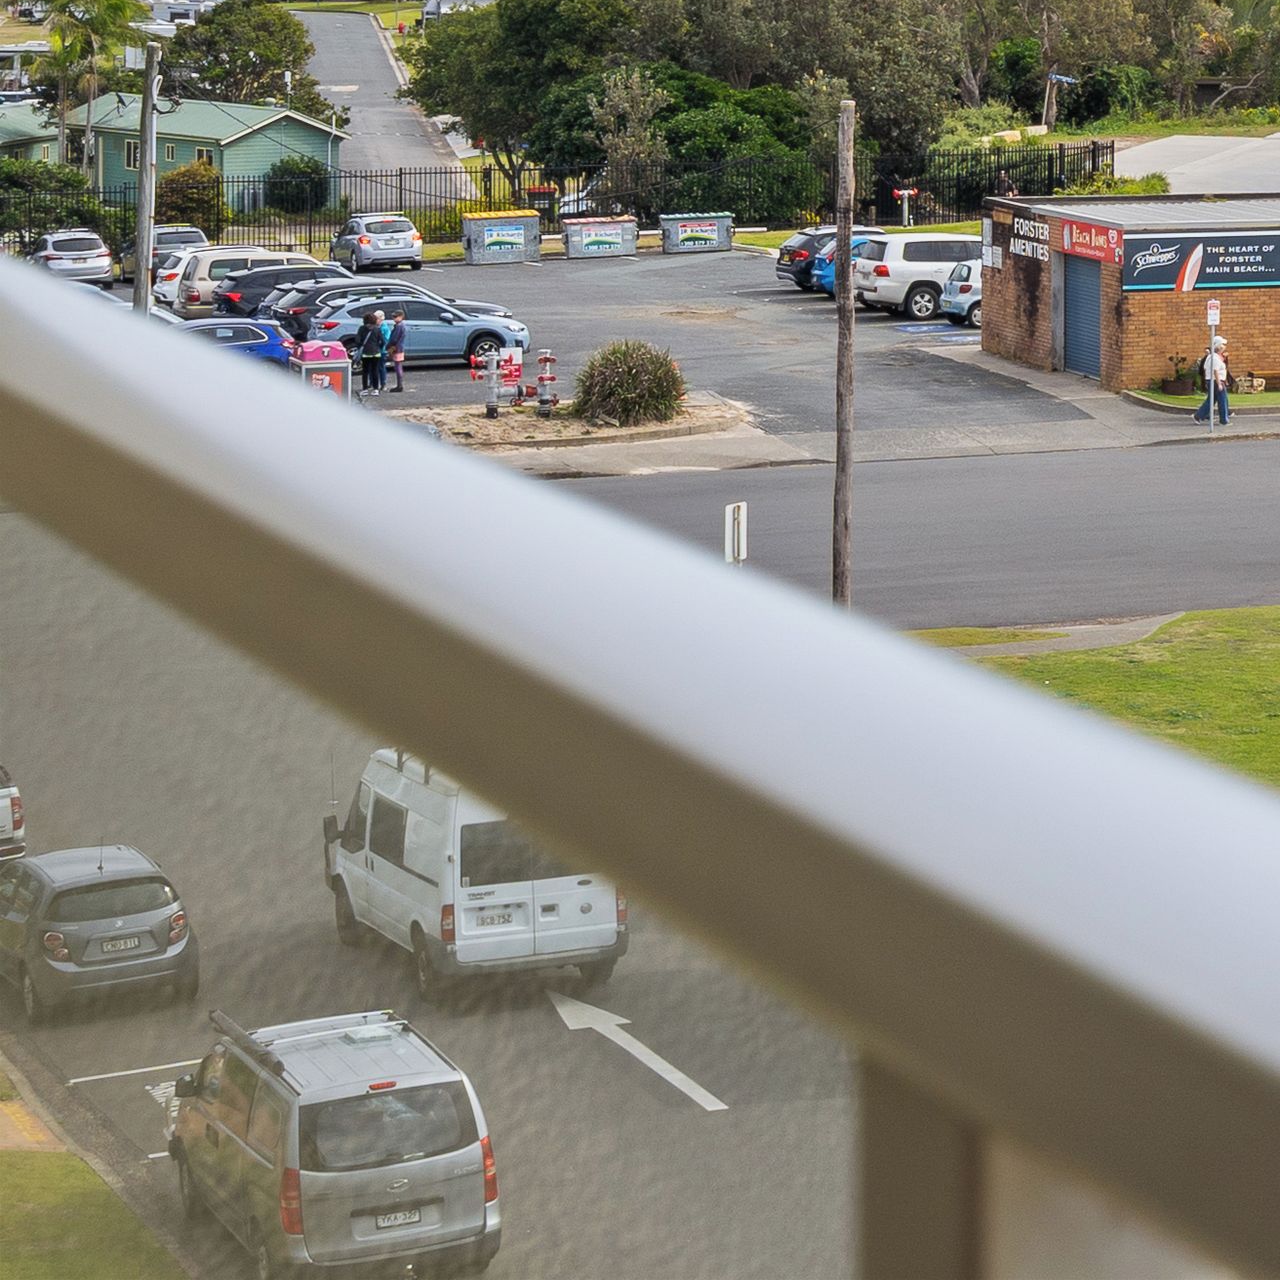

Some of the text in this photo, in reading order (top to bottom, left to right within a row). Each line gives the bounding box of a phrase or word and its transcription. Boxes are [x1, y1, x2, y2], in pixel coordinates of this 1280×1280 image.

[1014, 218, 1050, 240] FORSTER
[1009, 237, 1049, 261] AMENITIES
[1206, 246, 1225, 254] THE
[1228, 245, 1259, 253] HEART
[1136, 250, 1176, 268] Schweppes
[1219, 255, 1262, 263] FORSTER
[1233, 265, 1275, 273] BEACH...
